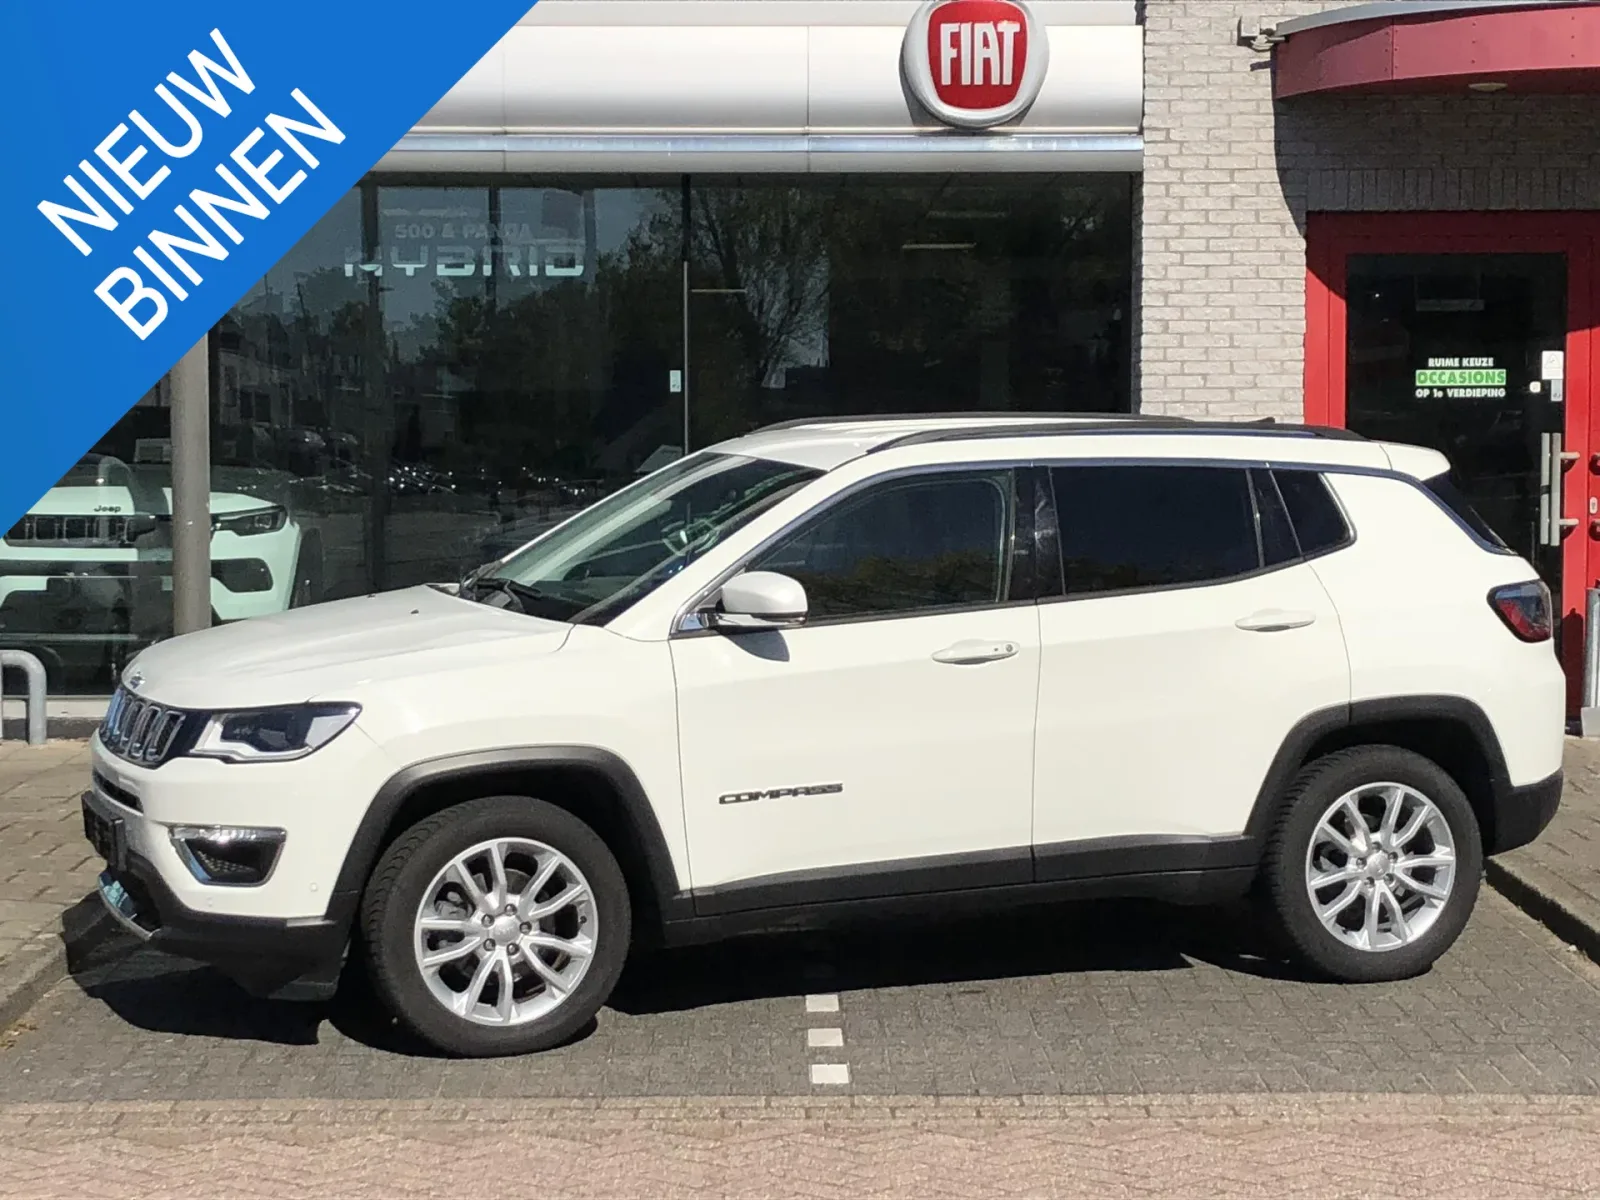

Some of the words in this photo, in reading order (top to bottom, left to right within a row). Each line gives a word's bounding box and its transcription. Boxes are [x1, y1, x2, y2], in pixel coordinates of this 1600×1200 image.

[940, 20, 1020, 86] FIAT
[395, 223, 435, 239] 500
[344, 245, 585, 277] HYBRID
[1428, 358, 1460, 367] RUIME
[1462, 358, 1494, 367] KEUZE
[1417, 371, 1505, 384] OCCASIONS
[1415, 388, 1430, 398] OP
[1447, 388, 1506, 398] VERDIEPING
[93, 504, 122, 514] Jeep
[719, 782, 843, 804] COMPASS
